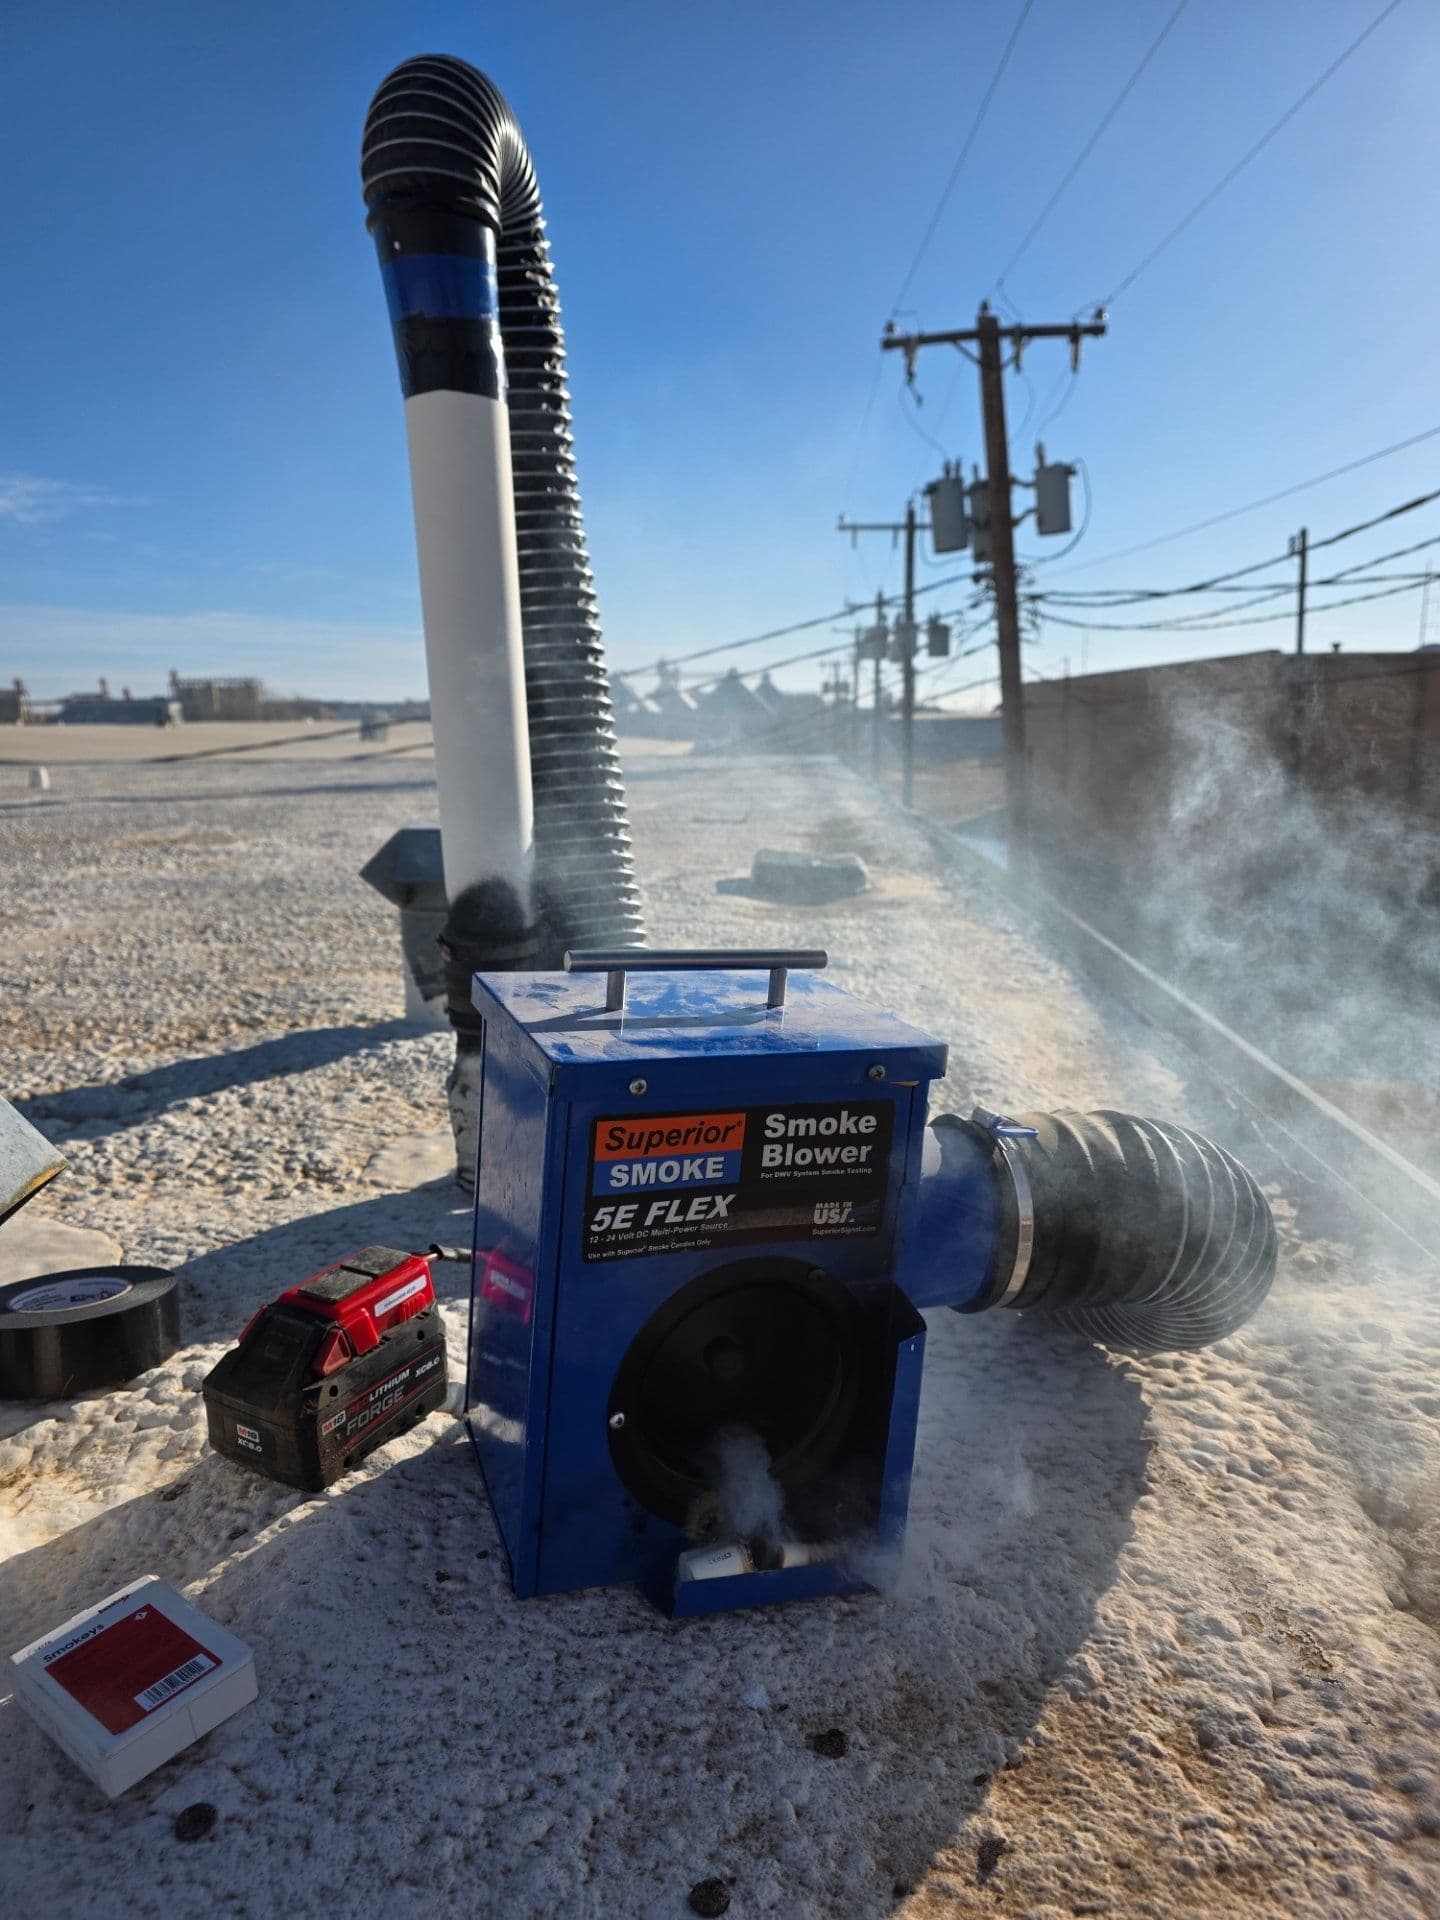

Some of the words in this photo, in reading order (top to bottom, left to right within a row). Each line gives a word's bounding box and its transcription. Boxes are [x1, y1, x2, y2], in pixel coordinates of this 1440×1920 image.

[763, 1110, 878, 1139] Smoke
[761, 1142, 874, 1167] Blower
[609, 1156, 725, 1188] SMOKE
[793, 1169, 820, 1178] System
[847, 1167, 873, 1176] Testing
[589, 1203, 640, 1232] 5E
[644, 1193, 737, 1226] FLEX
[815, 1201, 840, 1209] MADE
[589, 1235, 599, 1244] 12
[606, 1234, 616, 1242] 24
[618, 1232, 635, 1241] Volt
[636, 1229, 650, 1239] DC
[651, 1225, 699, 1238] Multi-Power
[700, 1222, 729, 1231] Source
[588, 1252, 601, 1260] Use
[602, 1250, 616, 1258] with
[647, 1244, 670, 1252] Smoke
[671, 1240, 695, 1249] Candles
[696, 1239, 712, 1247] Only
[322, 1411, 345, 1434] M18
[346, 1384, 406, 1436] FORGE
[43, 1624, 105, 1663] Smokeys
